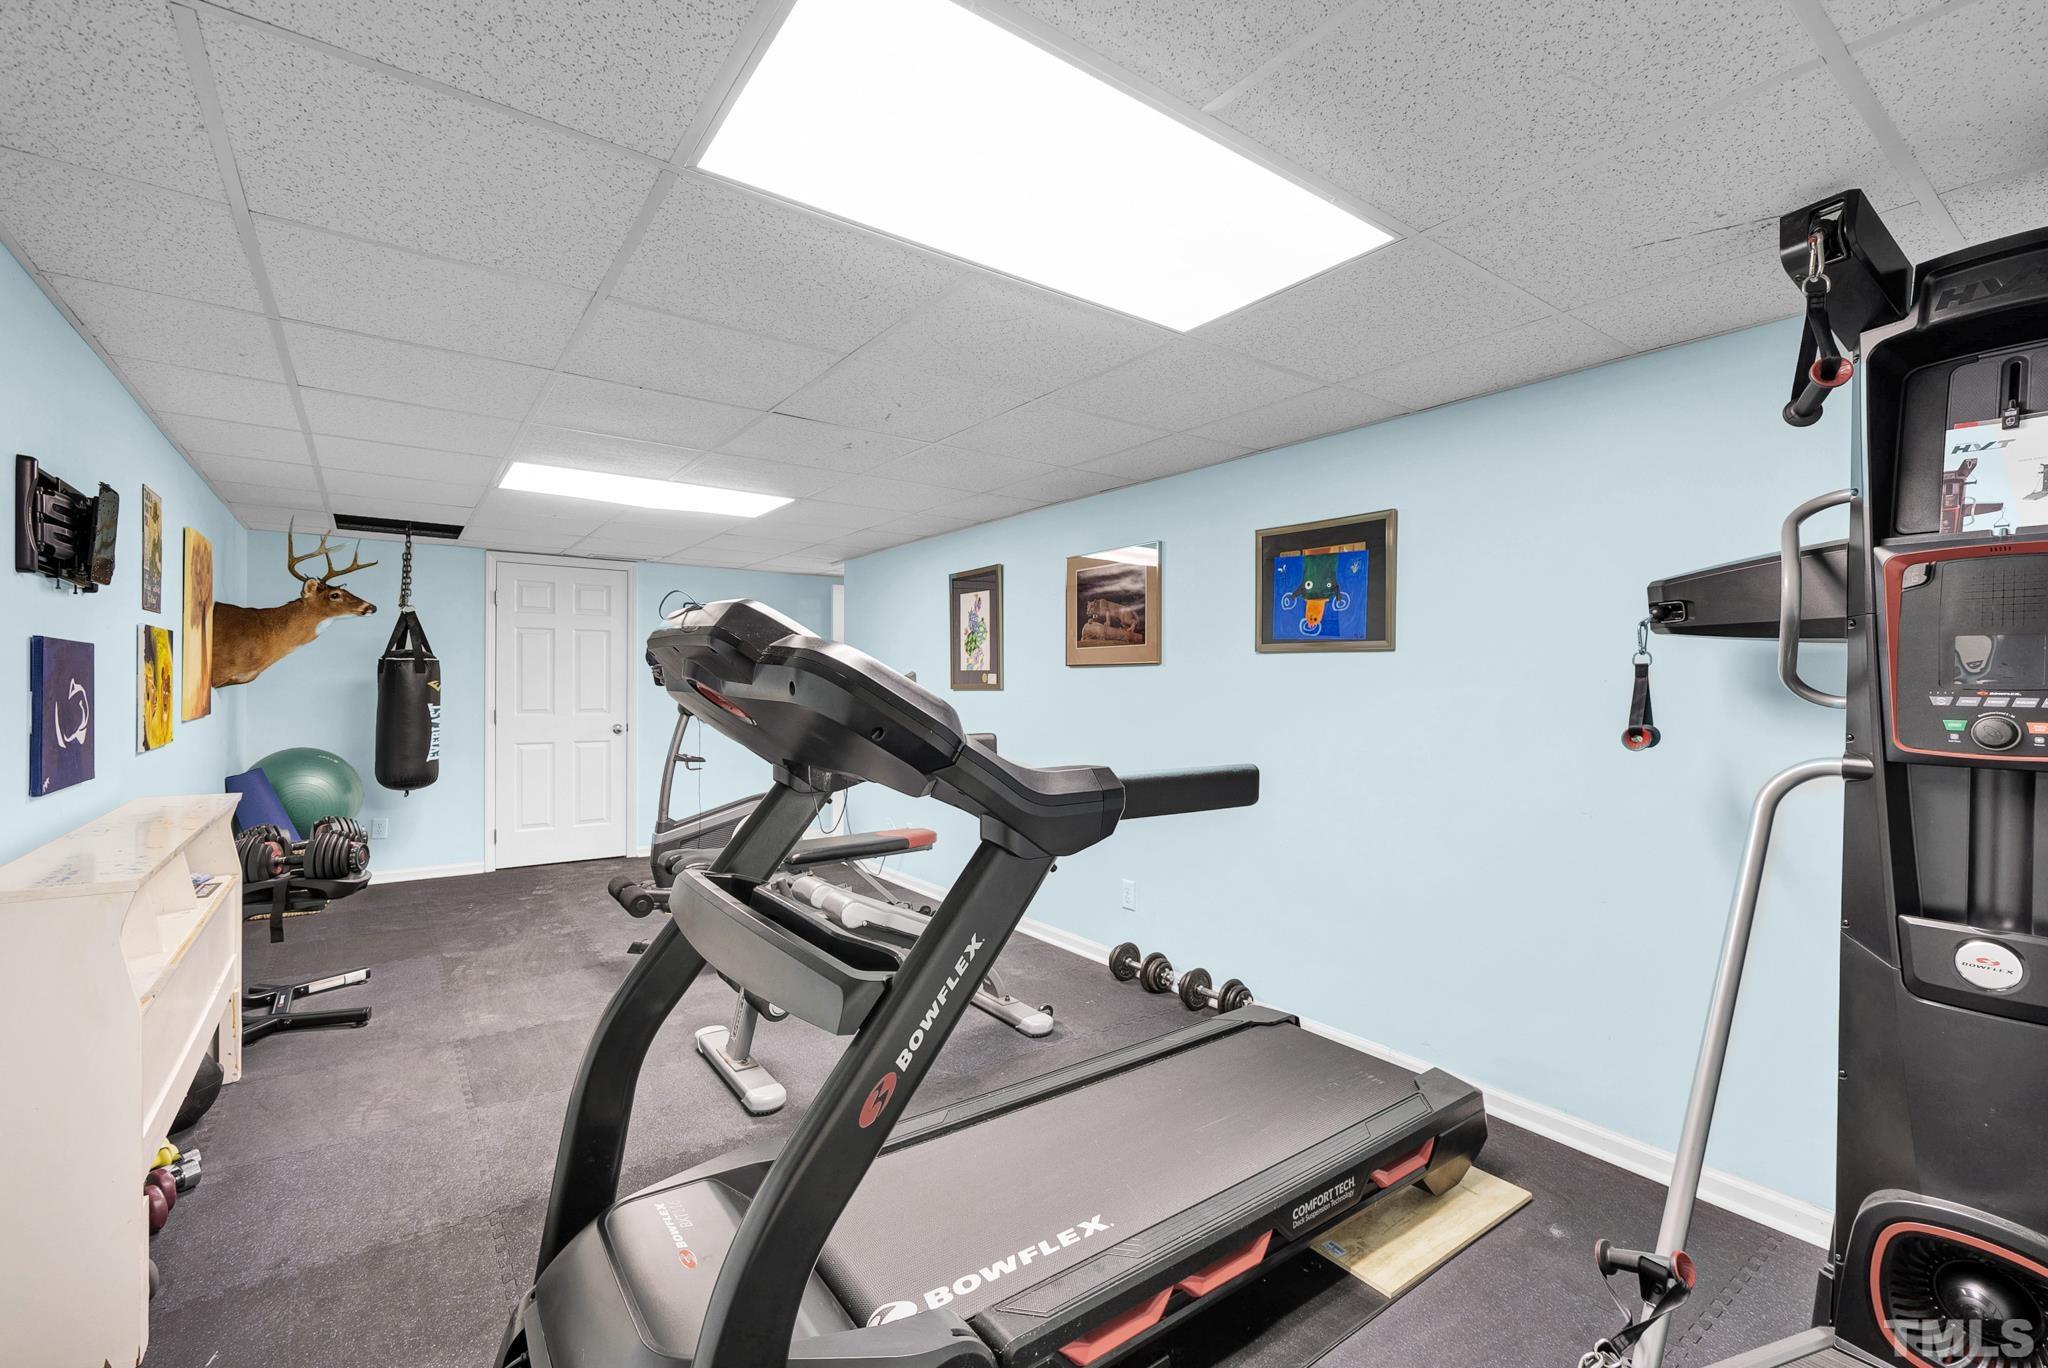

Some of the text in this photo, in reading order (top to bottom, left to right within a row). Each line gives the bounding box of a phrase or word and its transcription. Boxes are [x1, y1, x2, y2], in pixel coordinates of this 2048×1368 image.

[1951, 439, 2016, 454] HVT
[1962, 961, 2014, 975] BOWFLEX
[896, 932, 983, 1072] BOWFLEX
[1292, 1176, 1355, 1220] COMFORT TECH
[1292, 1190, 1355, 1229] Deck Suspension Technology
[923, 1214, 1110, 1310] BOWFLEX
